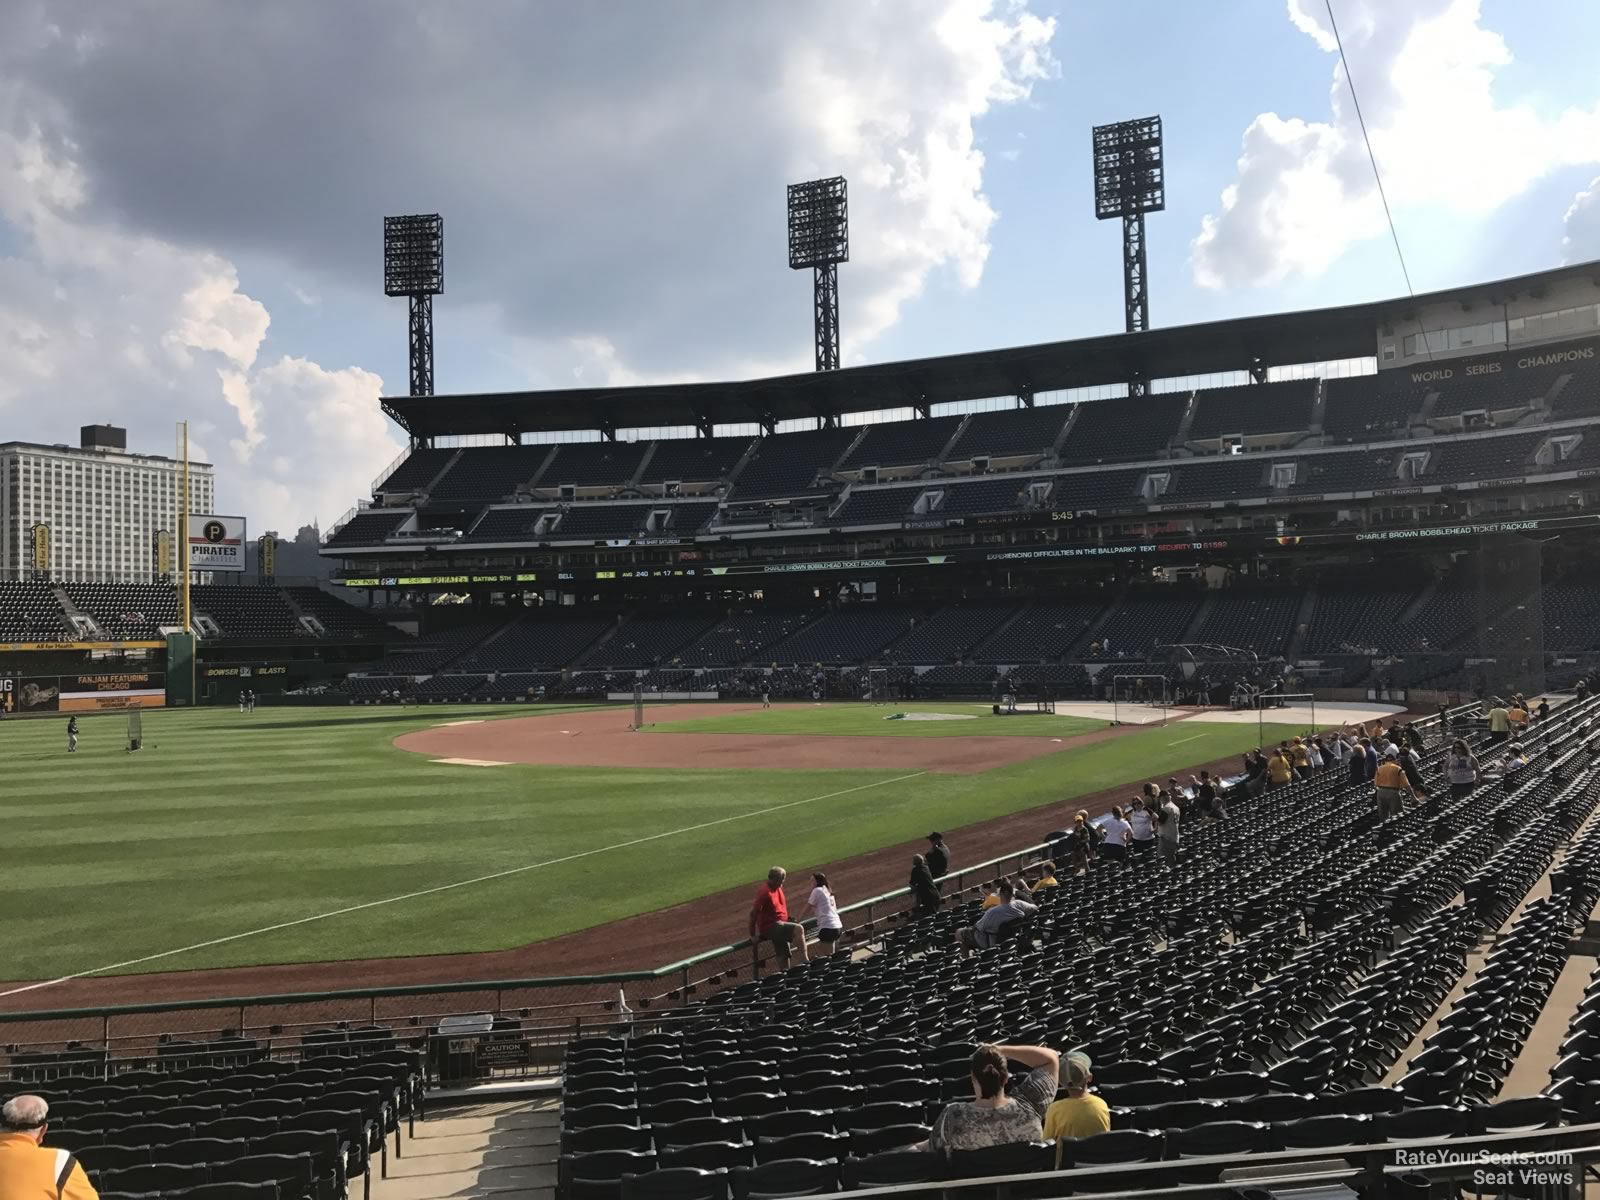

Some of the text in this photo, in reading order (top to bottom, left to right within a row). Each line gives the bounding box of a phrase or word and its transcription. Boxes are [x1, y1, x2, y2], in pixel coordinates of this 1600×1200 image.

[1411, 347, 1594, 383] WORLD SERIES CHAMPIONS
[1051, 511, 1073, 520] 5:45
[925, 520, 944, 528] BANK
[1356, 532, 1387, 540] CHARLIE
[1420, 527, 1471, 537] BOBBLEHEAD
[1472, 525, 1498, 533] TICKET
[1500, 521, 1538, 531] PACKAGE
[192, 546, 237, 556] PIRATES
[987, 551, 1032, 560] EXPERIENCING
[1033, 549, 1074, 558] DIFFICULTIES
[1098, 546, 1137, 554] BALLPARK?
[1158, 543, 1191, 551] SECURITY
[192, 555, 237, 563] CHARITIES
[208, 668, 239, 677] BOWSER
[259, 667, 287, 675] BLASTS
[78, 674, 148, 684] FANJAM FEATURING
[485, 1044, 521, 1052] CAUTION
